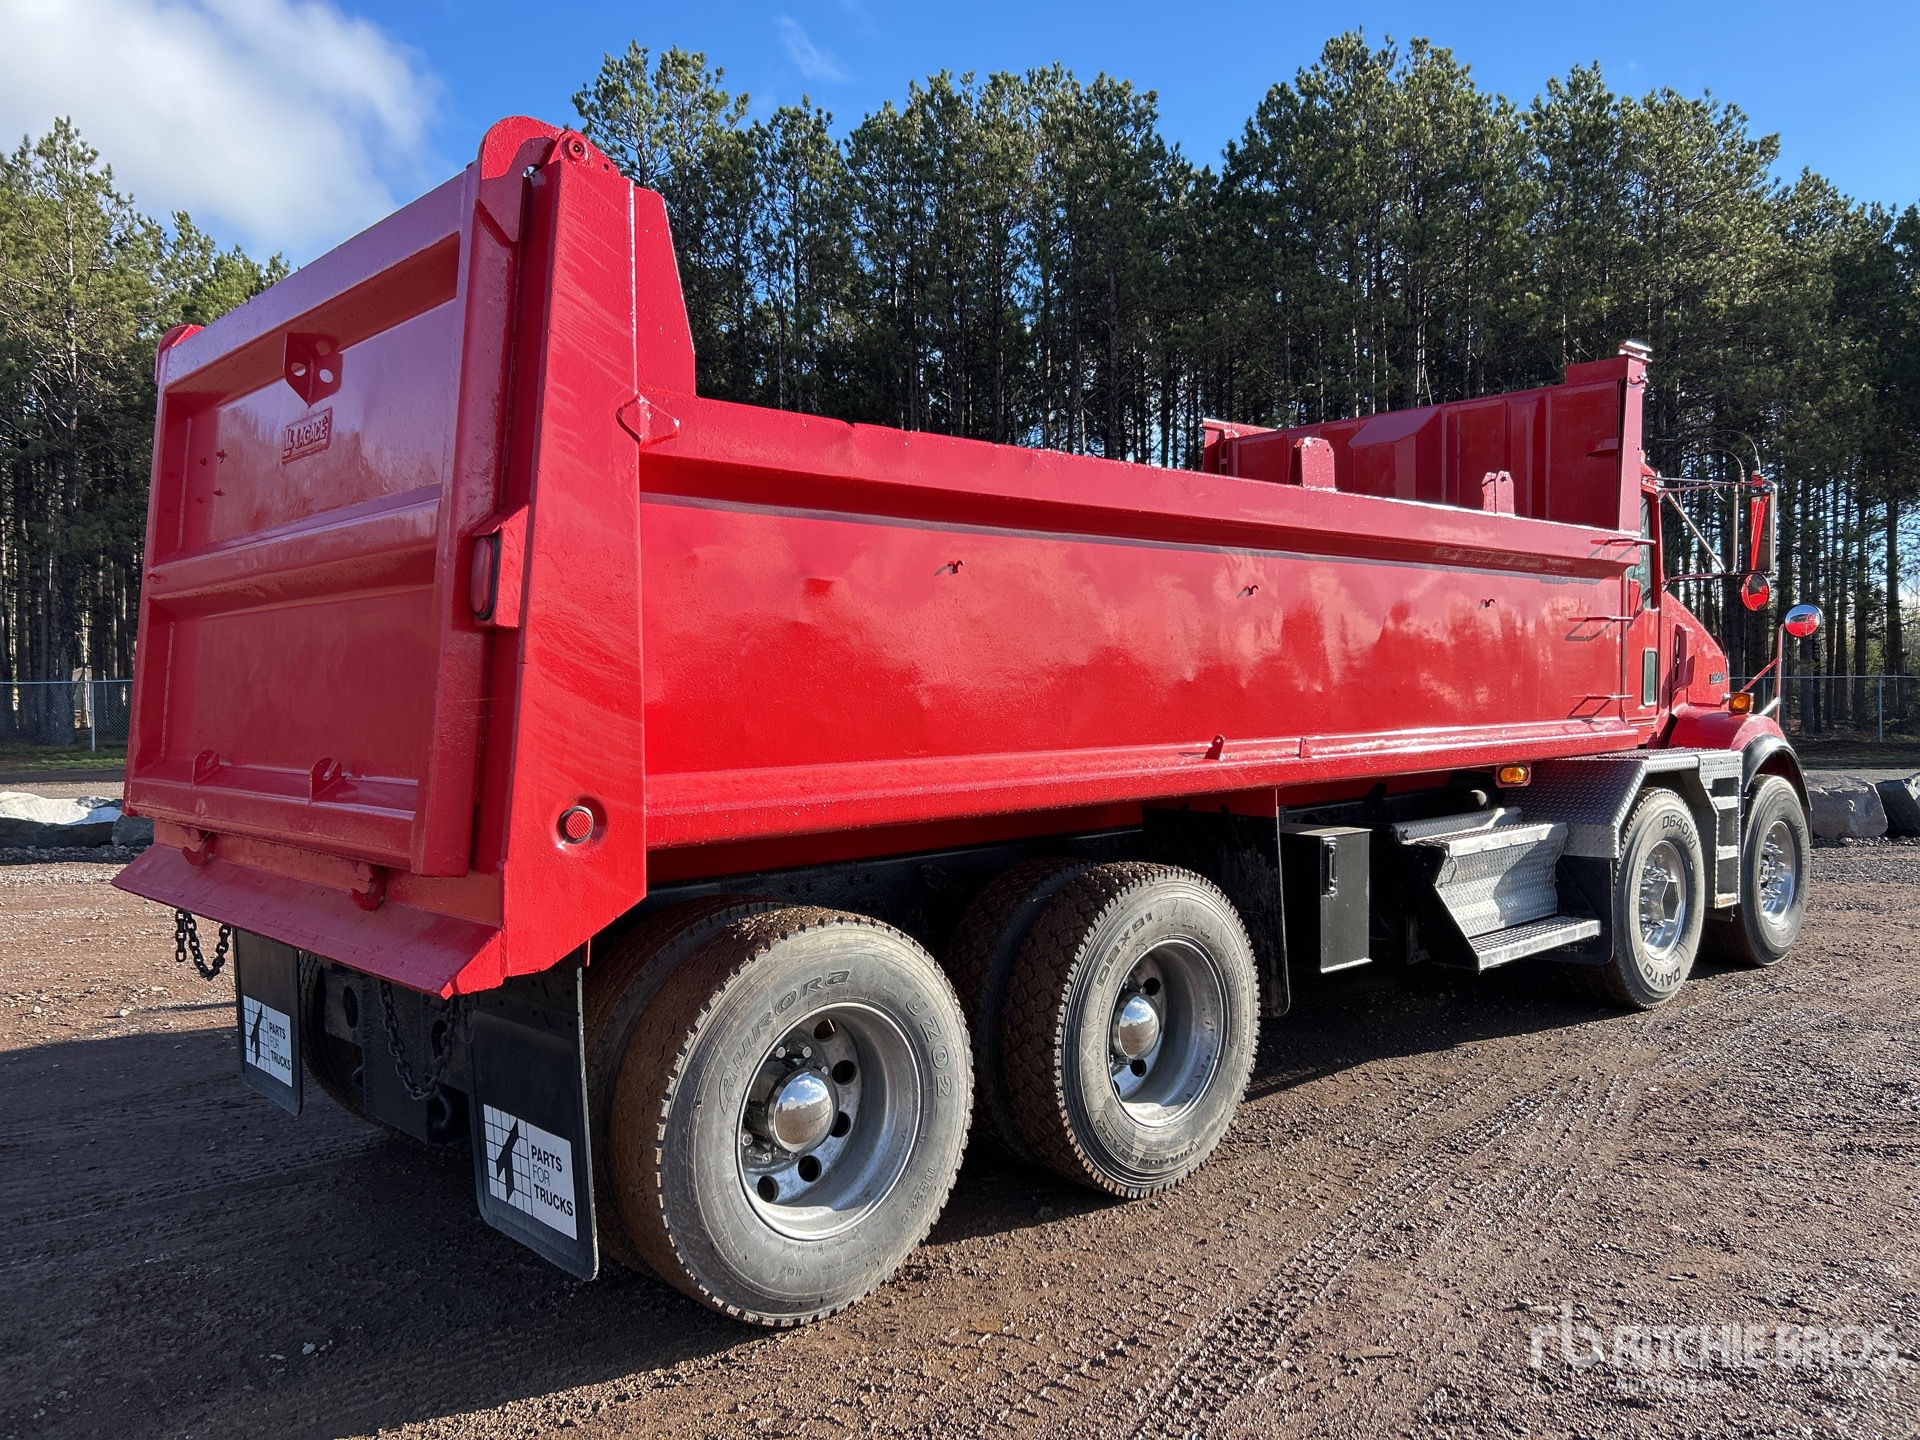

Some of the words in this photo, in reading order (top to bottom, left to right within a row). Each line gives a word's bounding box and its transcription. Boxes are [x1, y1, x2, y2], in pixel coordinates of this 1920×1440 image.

[269, 1022, 286, 1039] PARTS
[270, 1036, 280, 1050] FOR
[271, 1050, 291, 1071] TRUCKS
[531, 1145, 562, 1173] PARTS
[533, 1164, 550, 1186] FOR
[534, 1184, 573, 1217] TRUCKS
